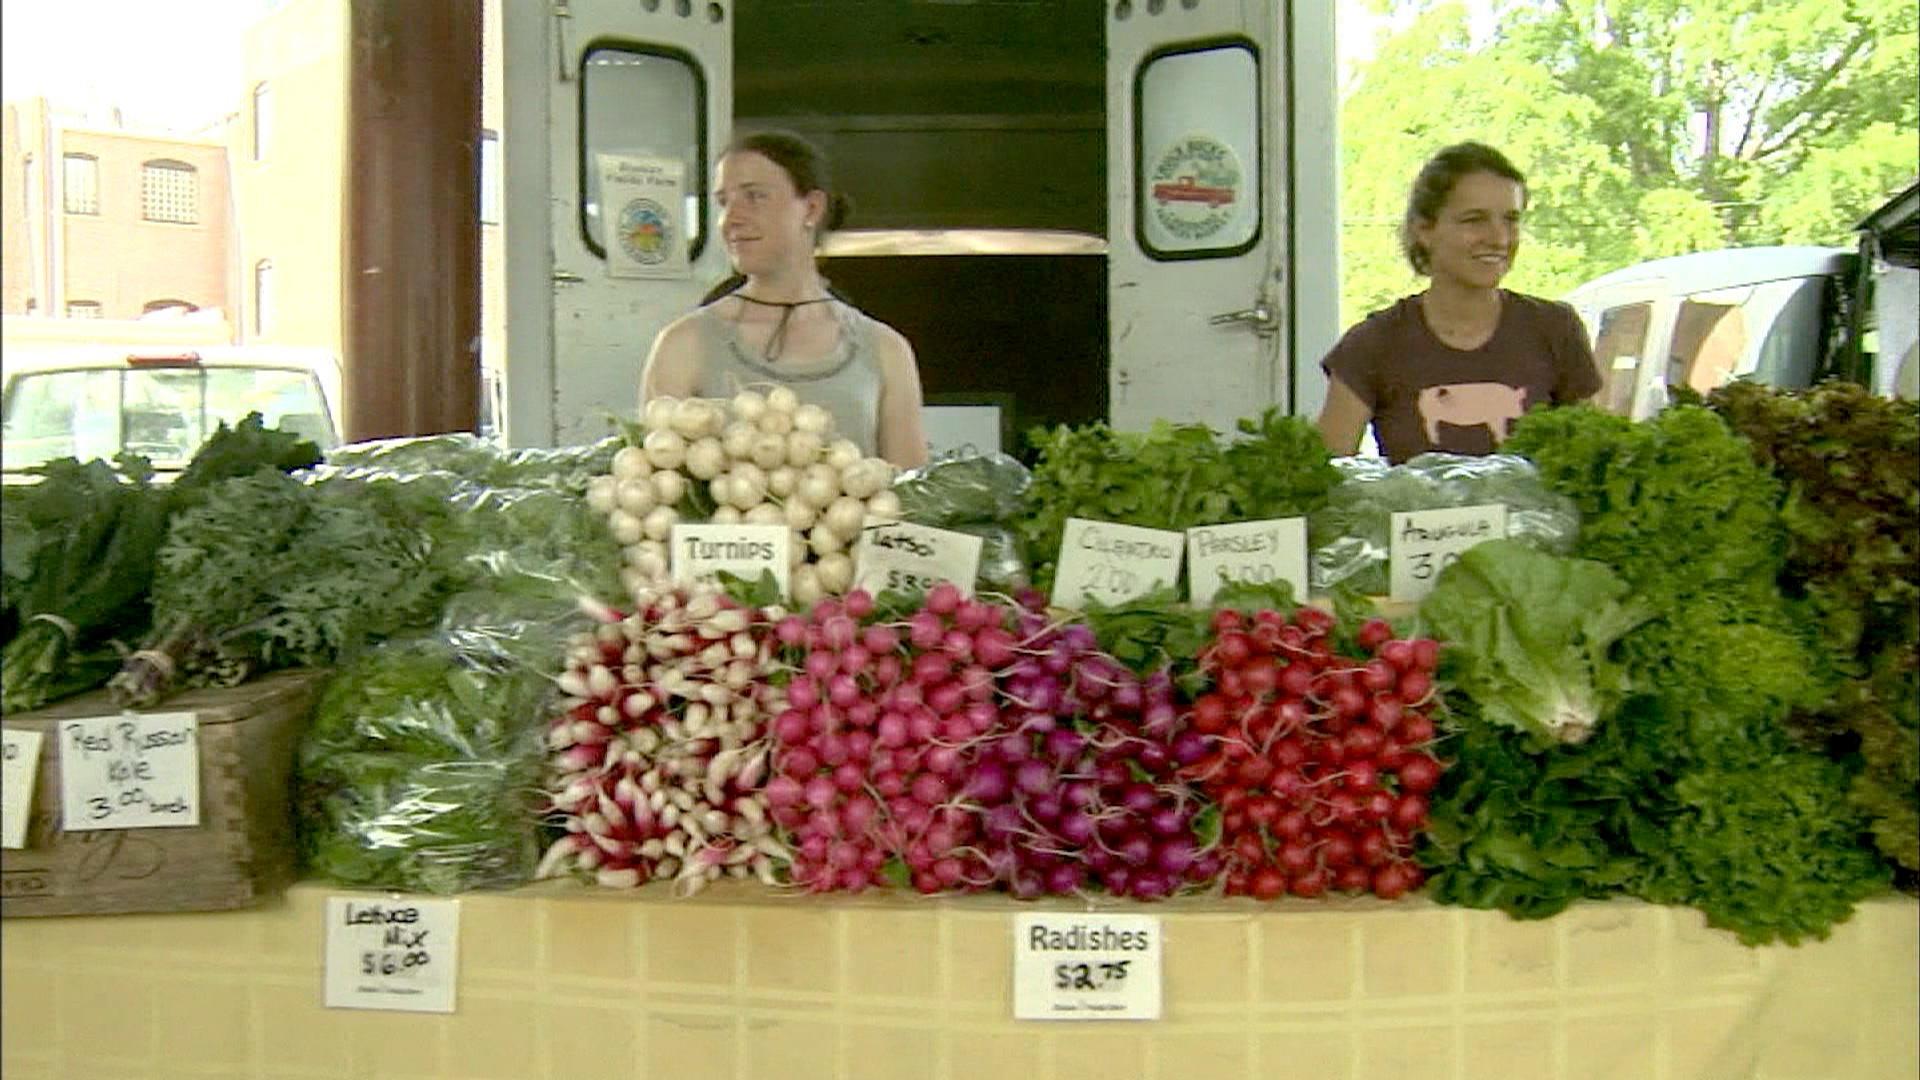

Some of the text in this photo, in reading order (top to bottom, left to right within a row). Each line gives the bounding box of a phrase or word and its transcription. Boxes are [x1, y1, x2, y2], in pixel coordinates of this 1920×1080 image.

[683, 535, 777, 562] Turnips
[1030, 923, 1150, 951] Radishes
[1054, 959, 1133, 990] $2.75
